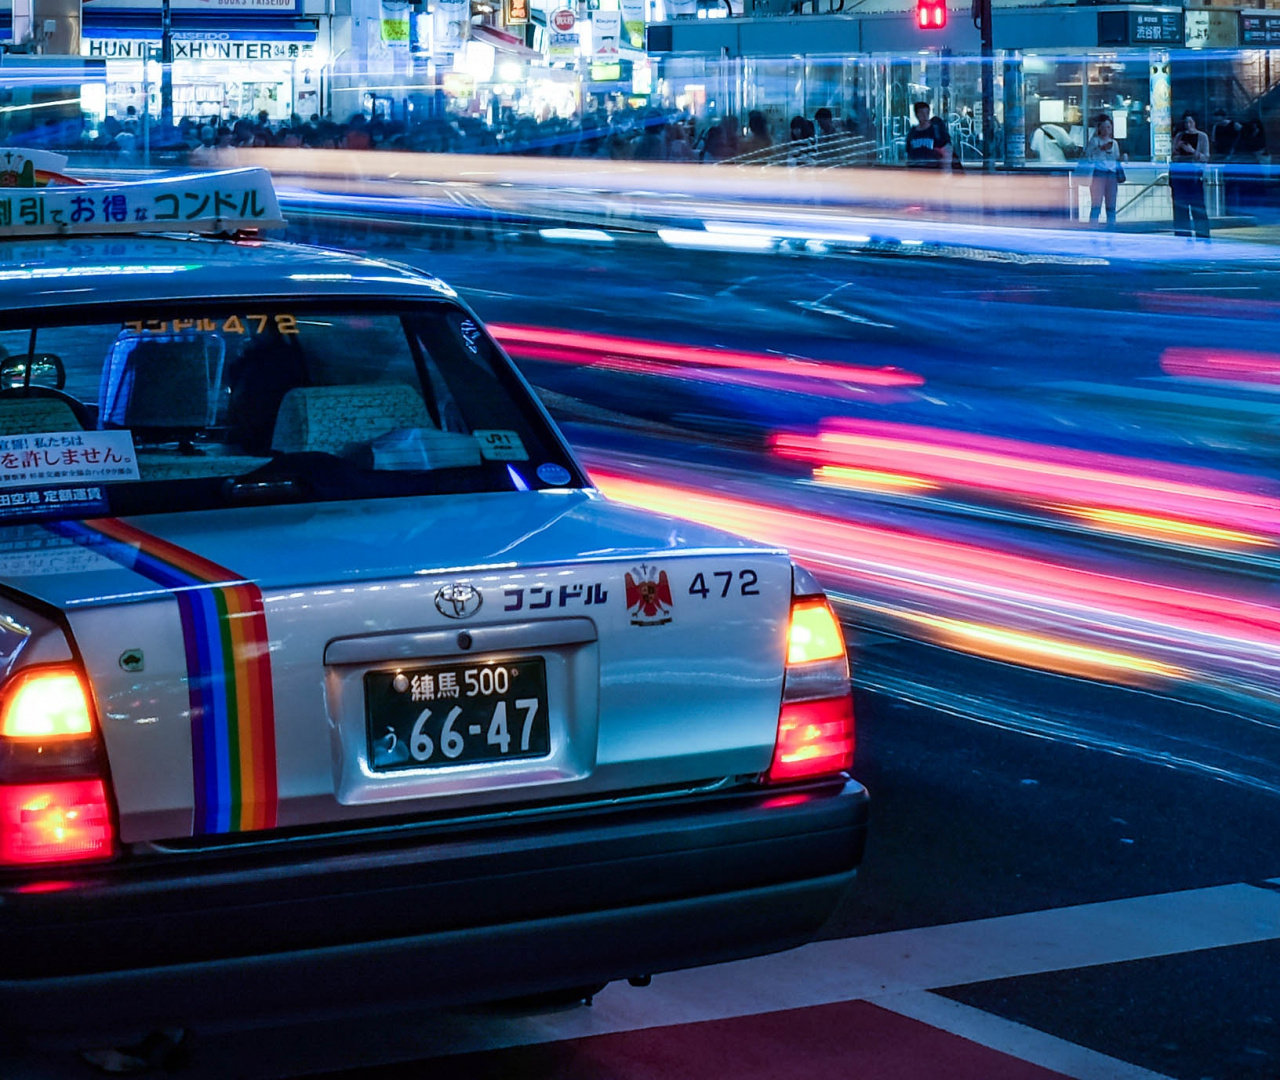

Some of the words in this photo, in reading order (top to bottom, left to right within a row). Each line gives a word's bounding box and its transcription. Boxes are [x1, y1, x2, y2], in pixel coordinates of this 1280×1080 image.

[1136, 25, 1162, 40] 渋谷駅
[222, 314, 300, 334] 472
[34, 435, 84, 448] 私たちは
[44, 487, 103, 503] 定額運賃
[688, 569, 760, 600] 472
[502, 583, 608, 612] コンドル
[409, 672, 461, 702] 練馬
[466, 667, 510, 696] 500
[409, 698, 541, 762] 66-47
